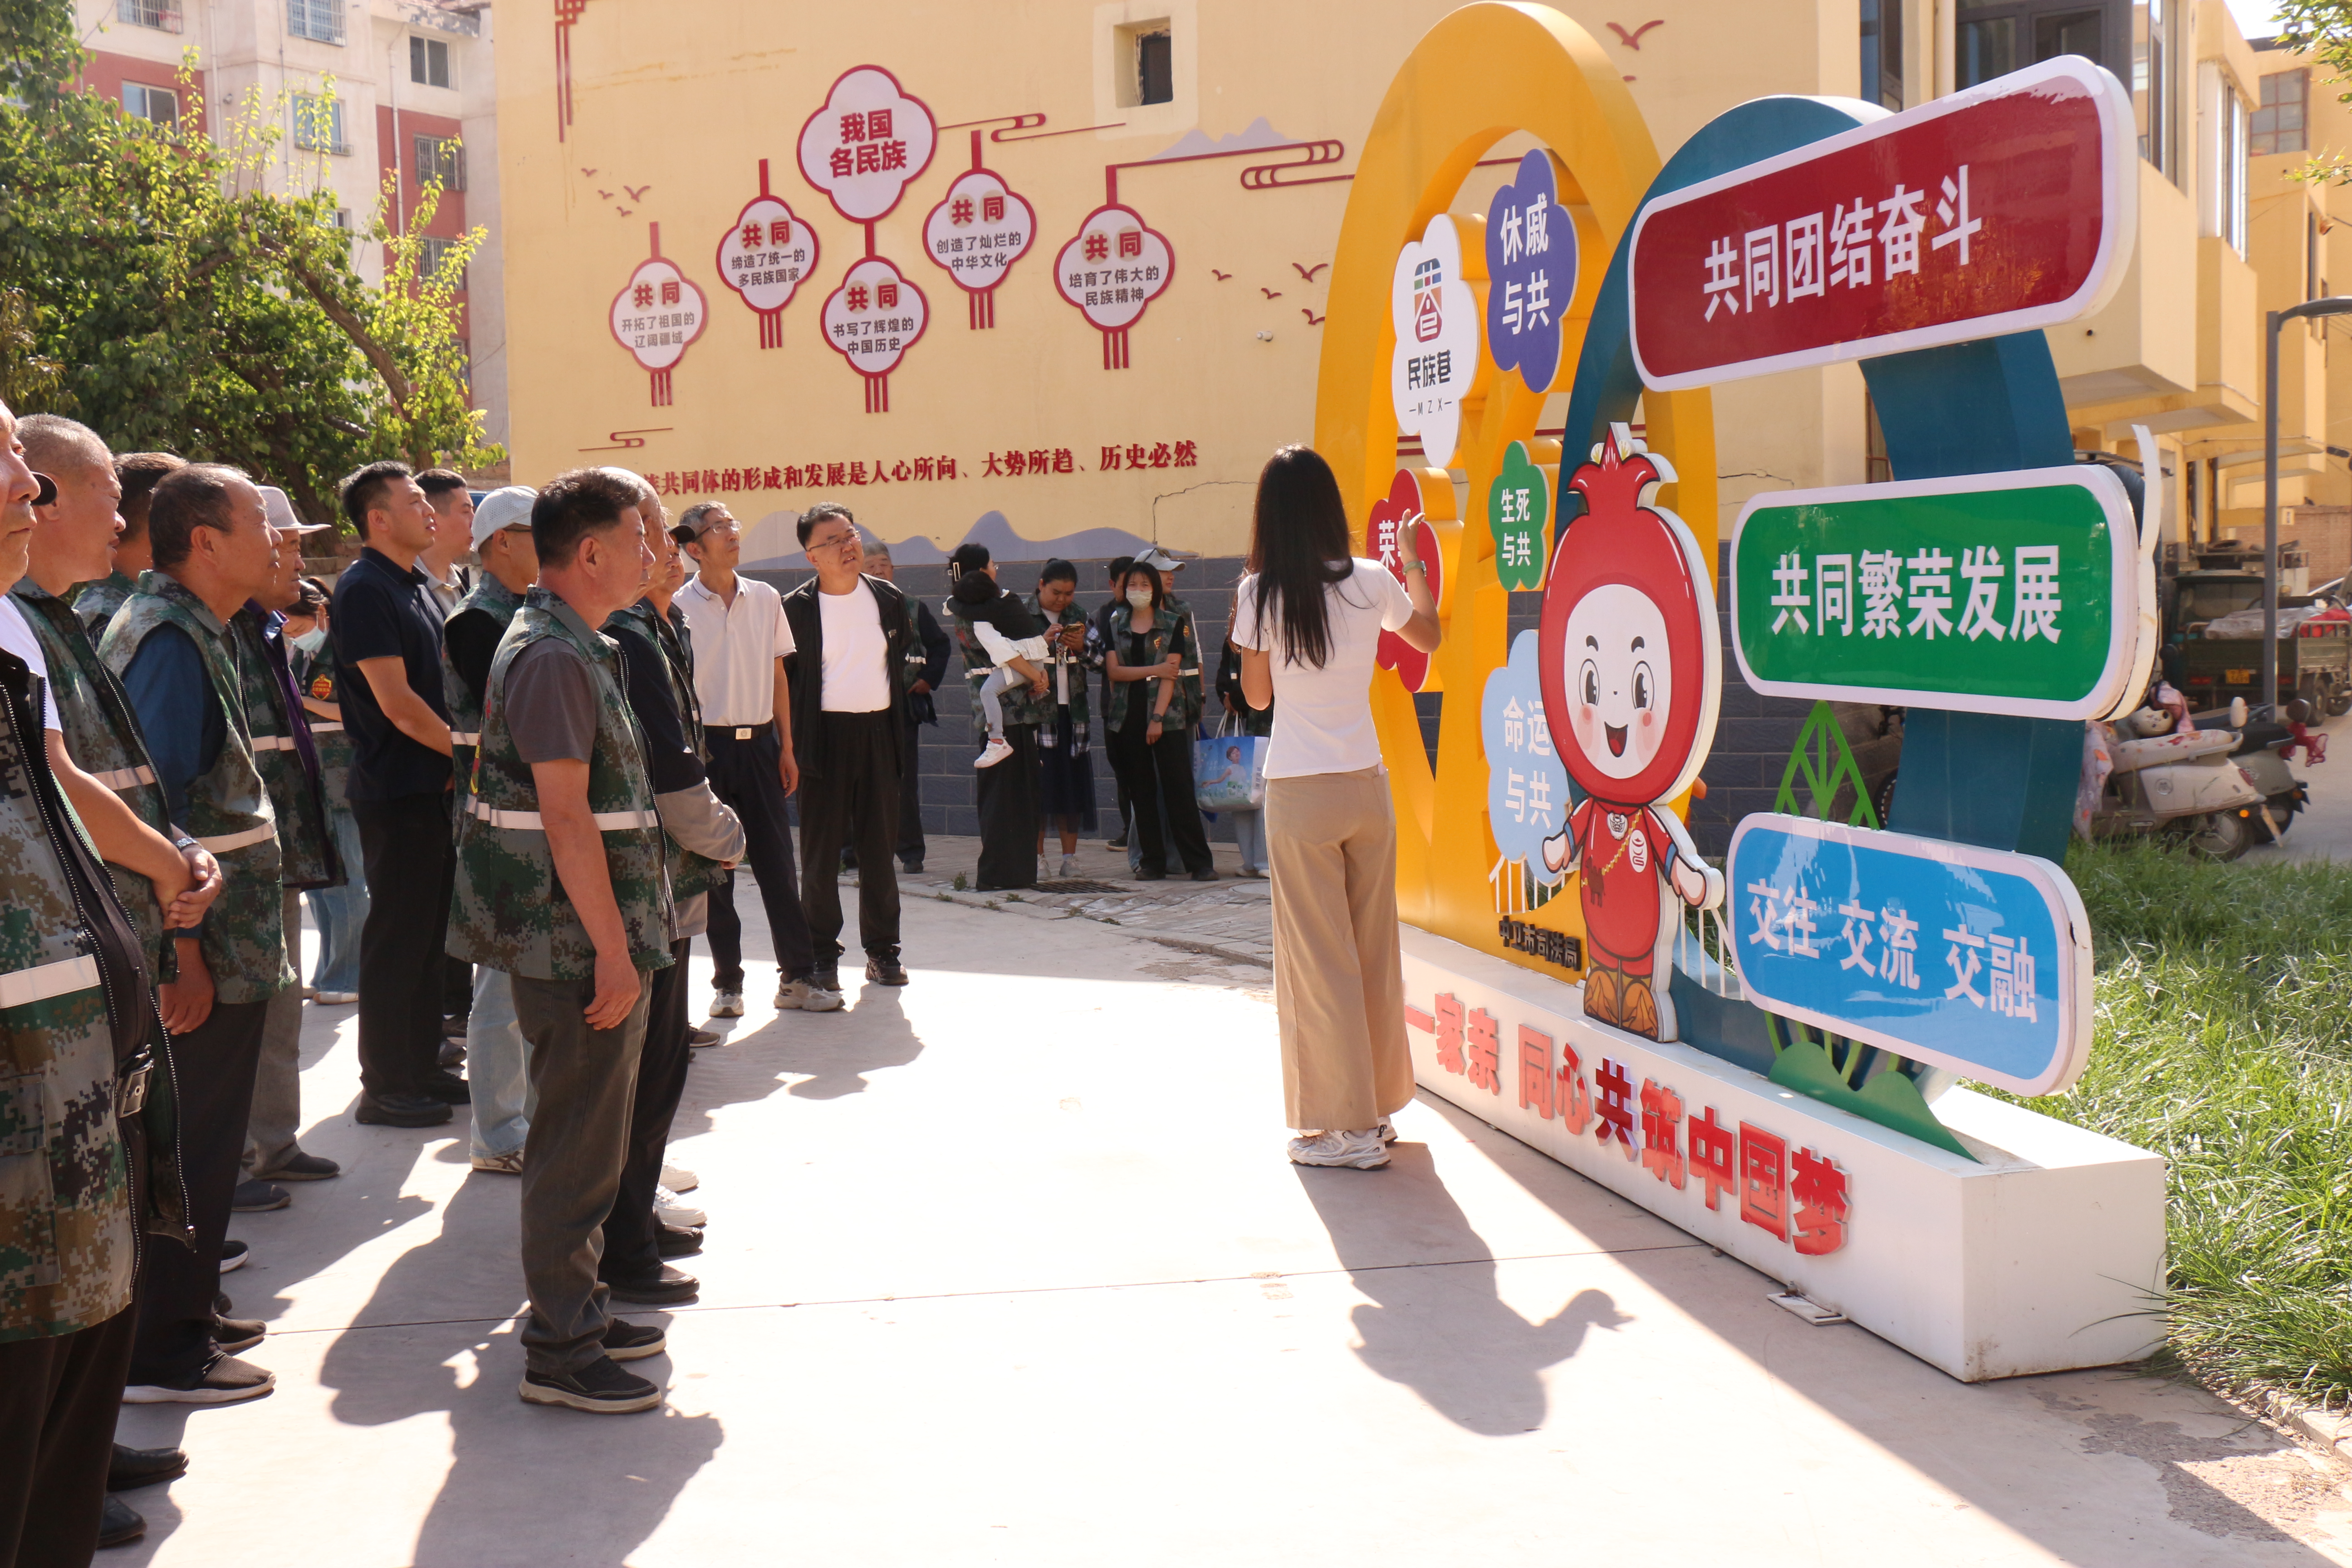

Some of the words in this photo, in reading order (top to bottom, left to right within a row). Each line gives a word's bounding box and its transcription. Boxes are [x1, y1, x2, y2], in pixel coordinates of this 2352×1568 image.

[841, 109, 893, 144] 我国
[829, 140, 907, 178] 各民族
[951, 196, 1004, 225] 共同
[742, 220, 790, 249] 共同
[936, 231, 1021, 254] 创造了灿烂的
[1500, 192, 1548, 266] 休戚
[1703, 165, 1982, 322] 共同团结奋斗
[731, 249, 805, 270] 缔造了统一的
[1086, 231, 1142, 261] 共同
[952, 252, 1007, 272] 中华文化
[1069, 265, 1159, 289] 培育了伟大的
[738, 268, 800, 287] 多民族国家
[634, 281, 680, 308] 共同
[847, 284, 898, 311] 共同
[1086, 287, 1145, 307] 民族精神
[1502, 269, 1550, 335] 与共
[622, 312, 695, 332] 开拓了祖国的
[833, 318, 914, 338] 书写了辉煌的
[634, 331, 683, 348] 辽阔疆域
[847, 337, 901, 355] 中国历史
[1408, 349, 1451, 391] 民族巷
[1501, 488, 1530, 523] 生死
[1502, 531, 1531, 567] 与共
[1771, 545, 2062, 644] 共同繁荣发展
[1503, 696, 1551, 756] 命运
[1505, 767, 1552, 829] 与共
[1499, 915, 1581, 971] 中卫市司法局
[1747, 878, 1820, 960] 交往
[1838, 899, 1921, 990] 交流
[1943, 923, 2038, 1024] 交融
[1518, 1023, 1852, 1256] 同心共筑中国梦
